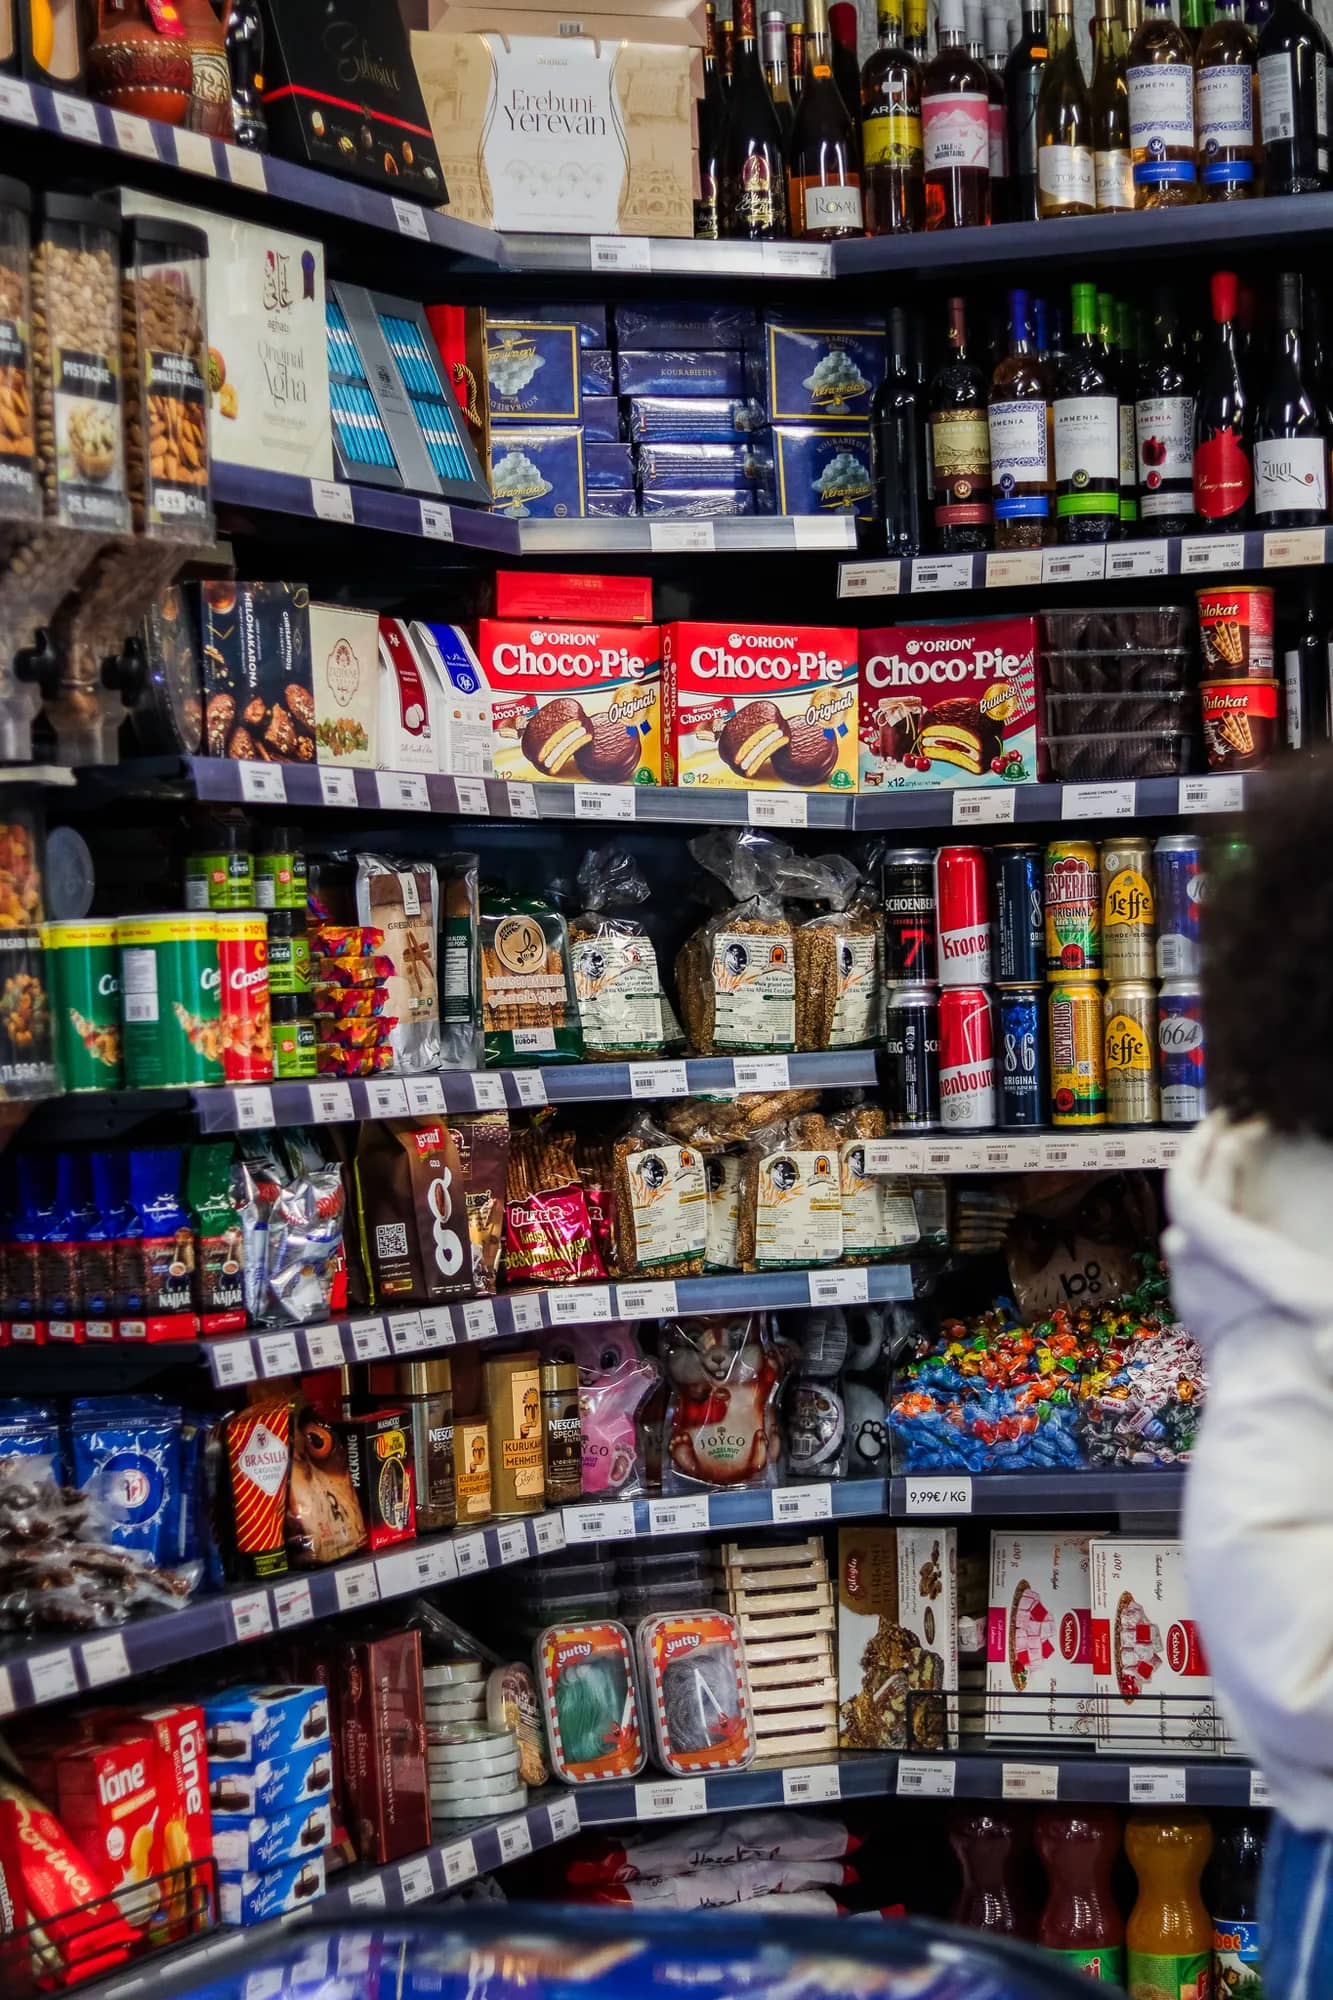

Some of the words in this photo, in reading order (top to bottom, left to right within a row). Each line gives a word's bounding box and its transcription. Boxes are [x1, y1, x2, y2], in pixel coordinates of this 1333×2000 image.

[1135, 81, 1175, 91] ARMENIA
[504, 105, 606, 135] Yerevan
[934, 150, 965, 160] MOUNTAINS
[63, 360, 111, 384] PISTACHE
[1059, 415, 1100, 423] ARMENIA
[243, 592, 258, 688] MELOMAKARONA
[547, 633, 597, 646] ORION
[745, 635, 795, 648] ORION
[923, 638, 972, 652] ORION
[608, 688, 656, 723] Original
[806, 691, 853, 725] Original
[697, 773, 709, 784] 12
[1109, 887, 1151, 921] Leffe
[514, 1038, 538, 1046] EUROPE
[1106, 1032, 1144, 1066] Leffe
[1003, 1076, 1038, 1086] ORIGINAL
[701, 1434, 746, 1450] JOYCO
[348, 1434, 361, 1488] PACKUNG
[506, 1457, 538, 1466] MEHMET
[910, 1491, 940, 1504] 9,99€
[950, 1491, 967, 1502] KG
[1112, 1551, 1123, 1572] 400
[666, 1634, 701, 1655] yutty
[1064, 1620, 1074, 1654] Sebahat
[558, 1642, 592, 1665] yutty
[1170, 1630, 1181, 1666] Sebahat
